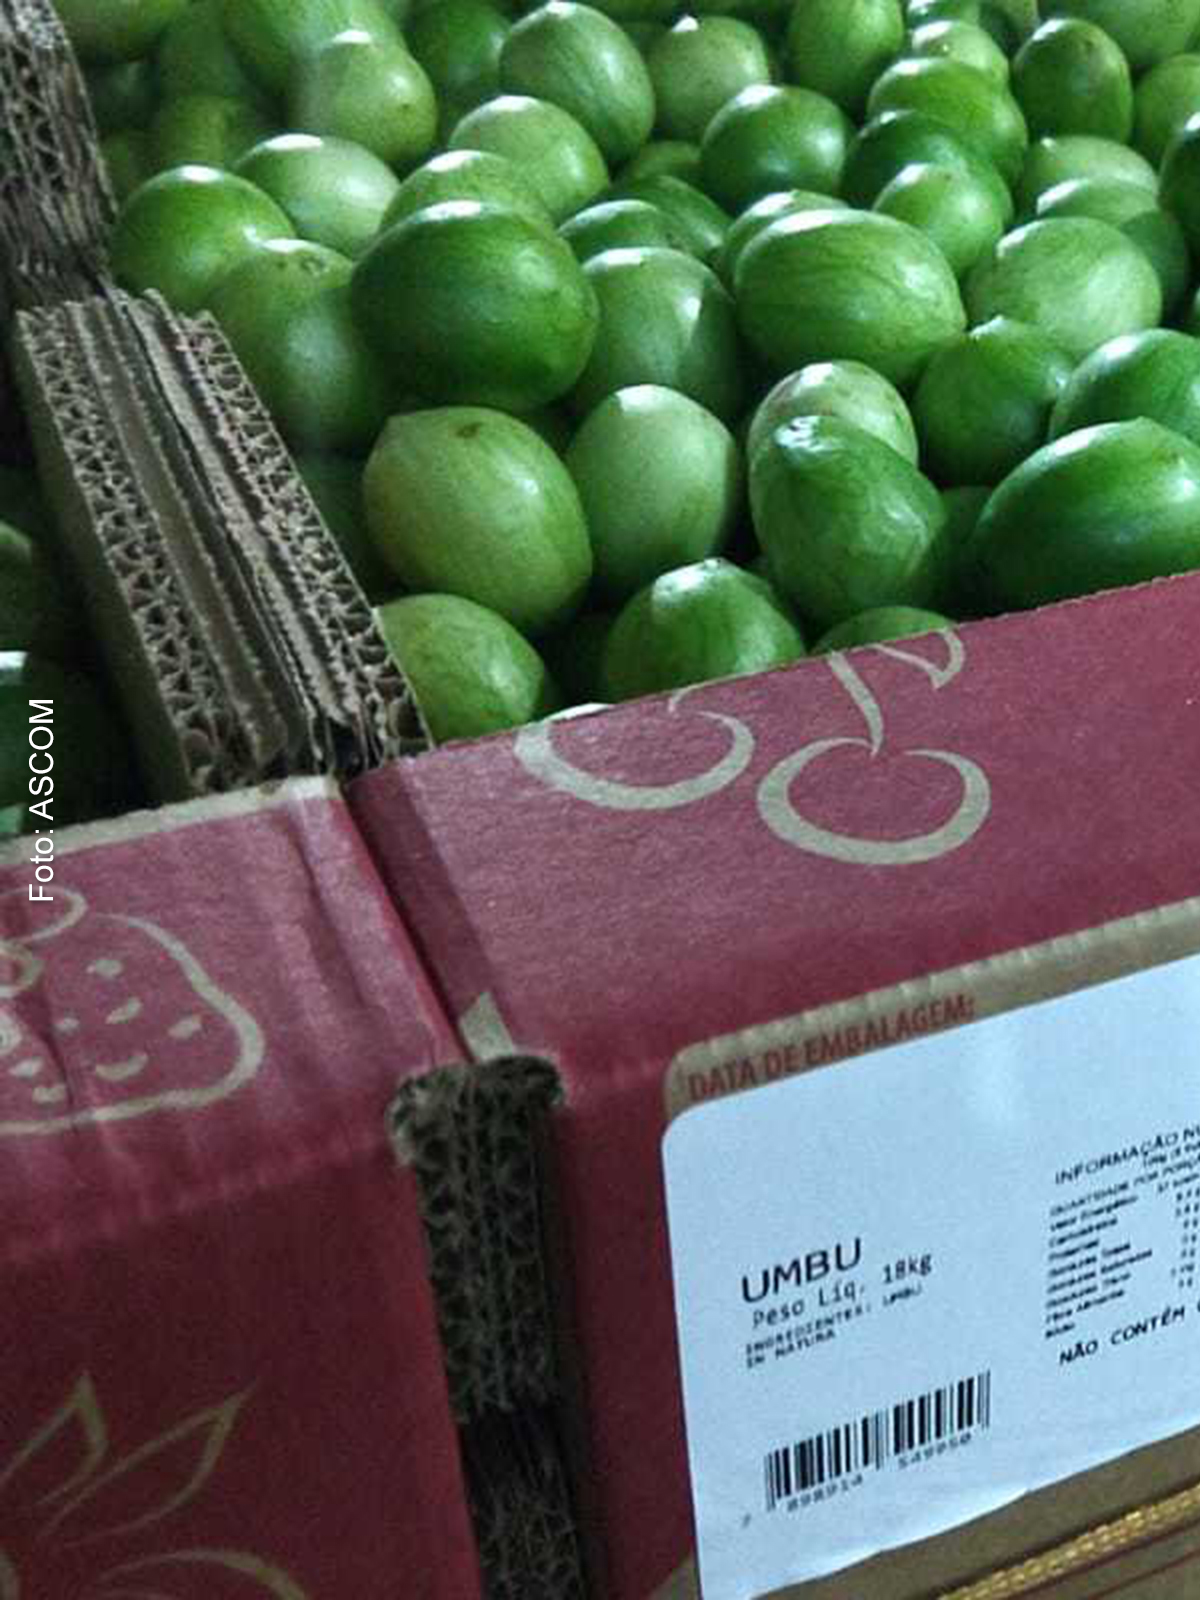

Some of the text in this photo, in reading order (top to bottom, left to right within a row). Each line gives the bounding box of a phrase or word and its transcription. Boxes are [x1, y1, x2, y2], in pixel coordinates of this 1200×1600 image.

[687, 993, 975, 1101] DATA DE EMBALAGEM:
[1055, 1130, 1179, 1184] INFORMAÇÃO
[742, 1237, 861, 1303] UMBU
[753, 1299, 804, 1330] Peso
[882, 1253, 932, 1285] 18kg
[774, 1327, 836, 1361] NATURA
[1059, 1340, 1099, 1365] NÃO
[1110, 1305, 1186, 1346] CONTÉM
